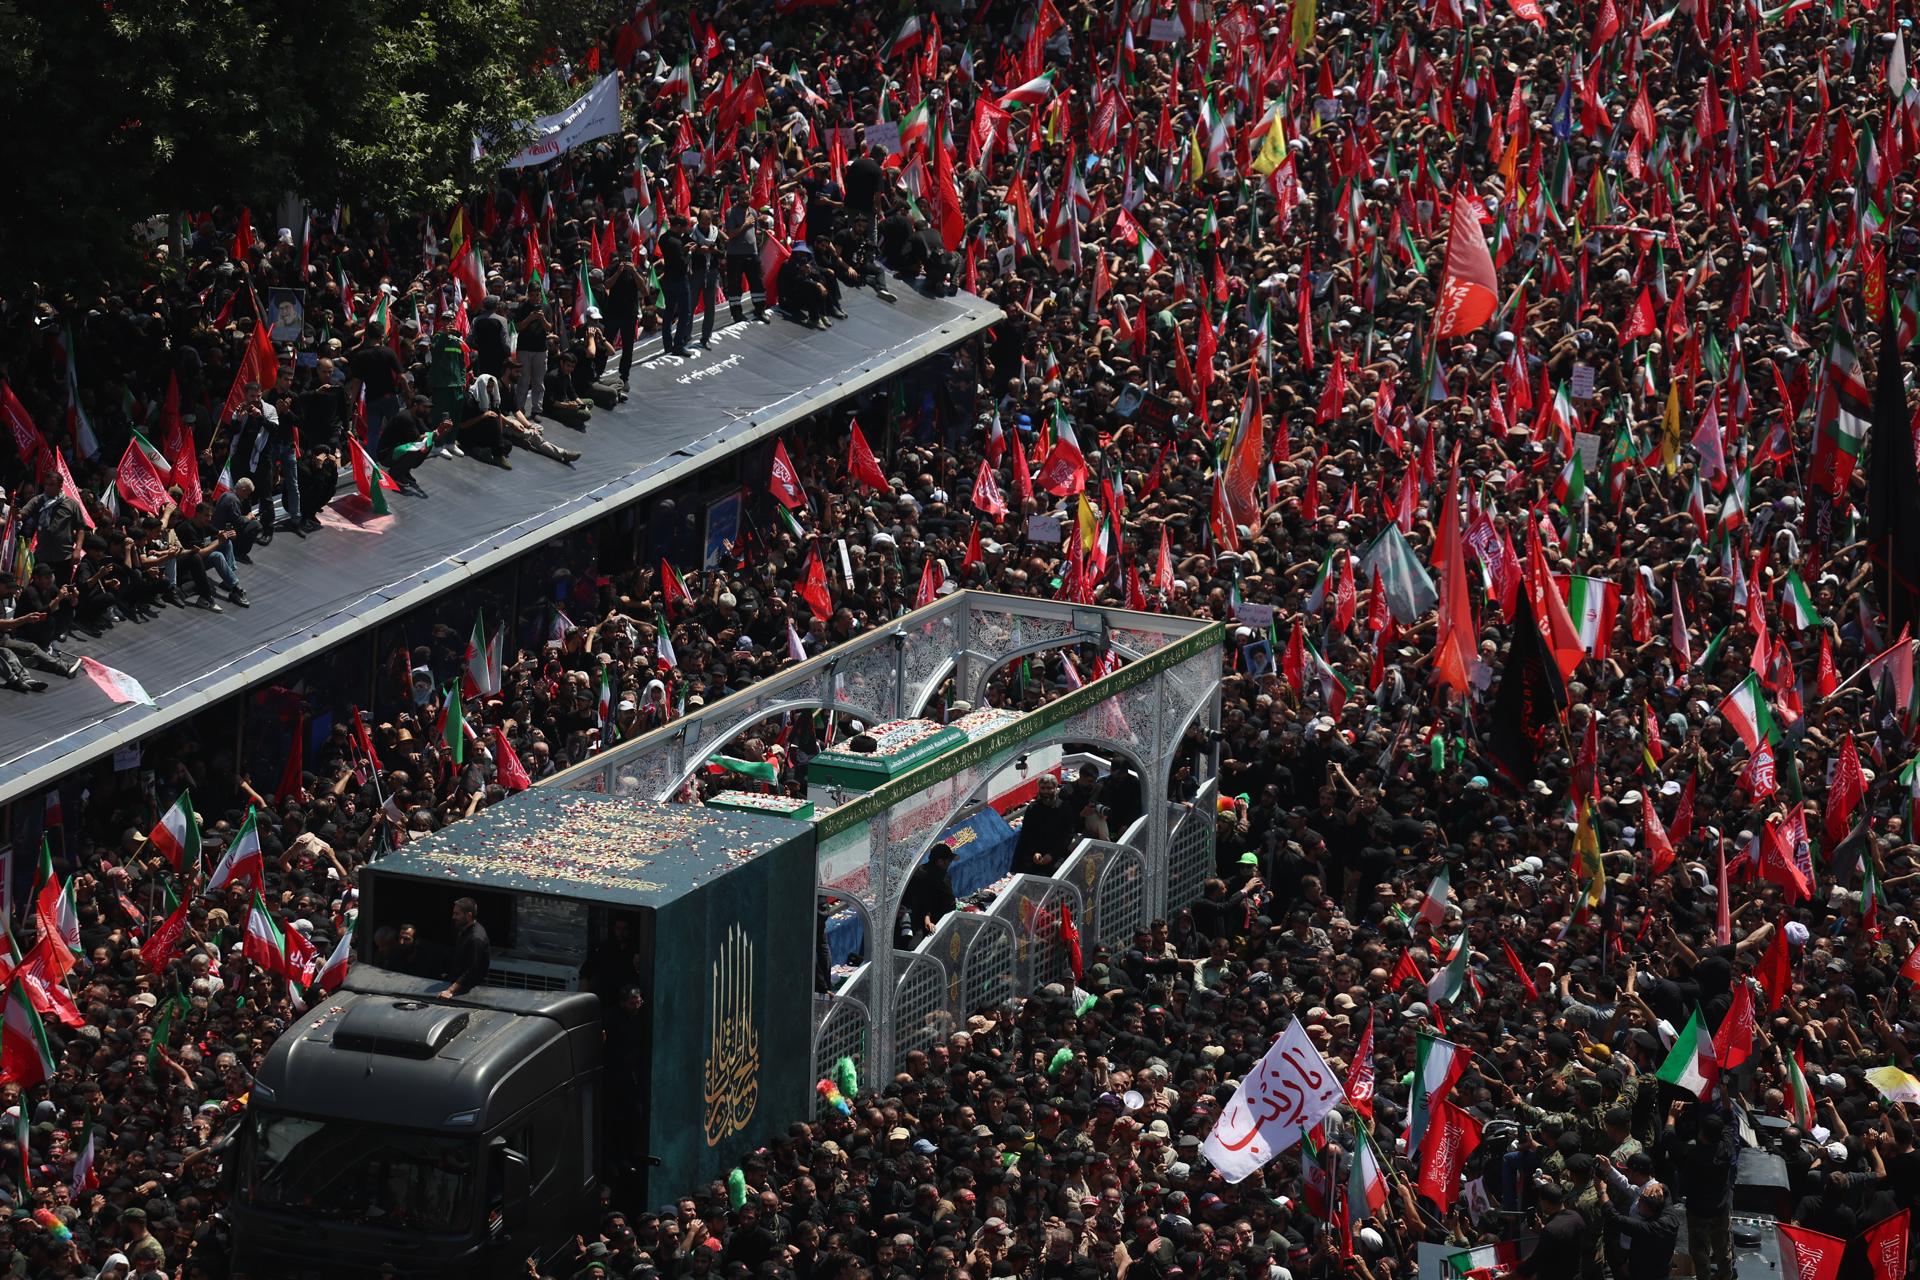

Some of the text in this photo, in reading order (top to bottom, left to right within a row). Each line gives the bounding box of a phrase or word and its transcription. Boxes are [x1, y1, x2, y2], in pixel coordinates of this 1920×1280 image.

[1441, 286, 1470, 334] DOWN
[1215, 1048, 1333, 1154] یا زینب
